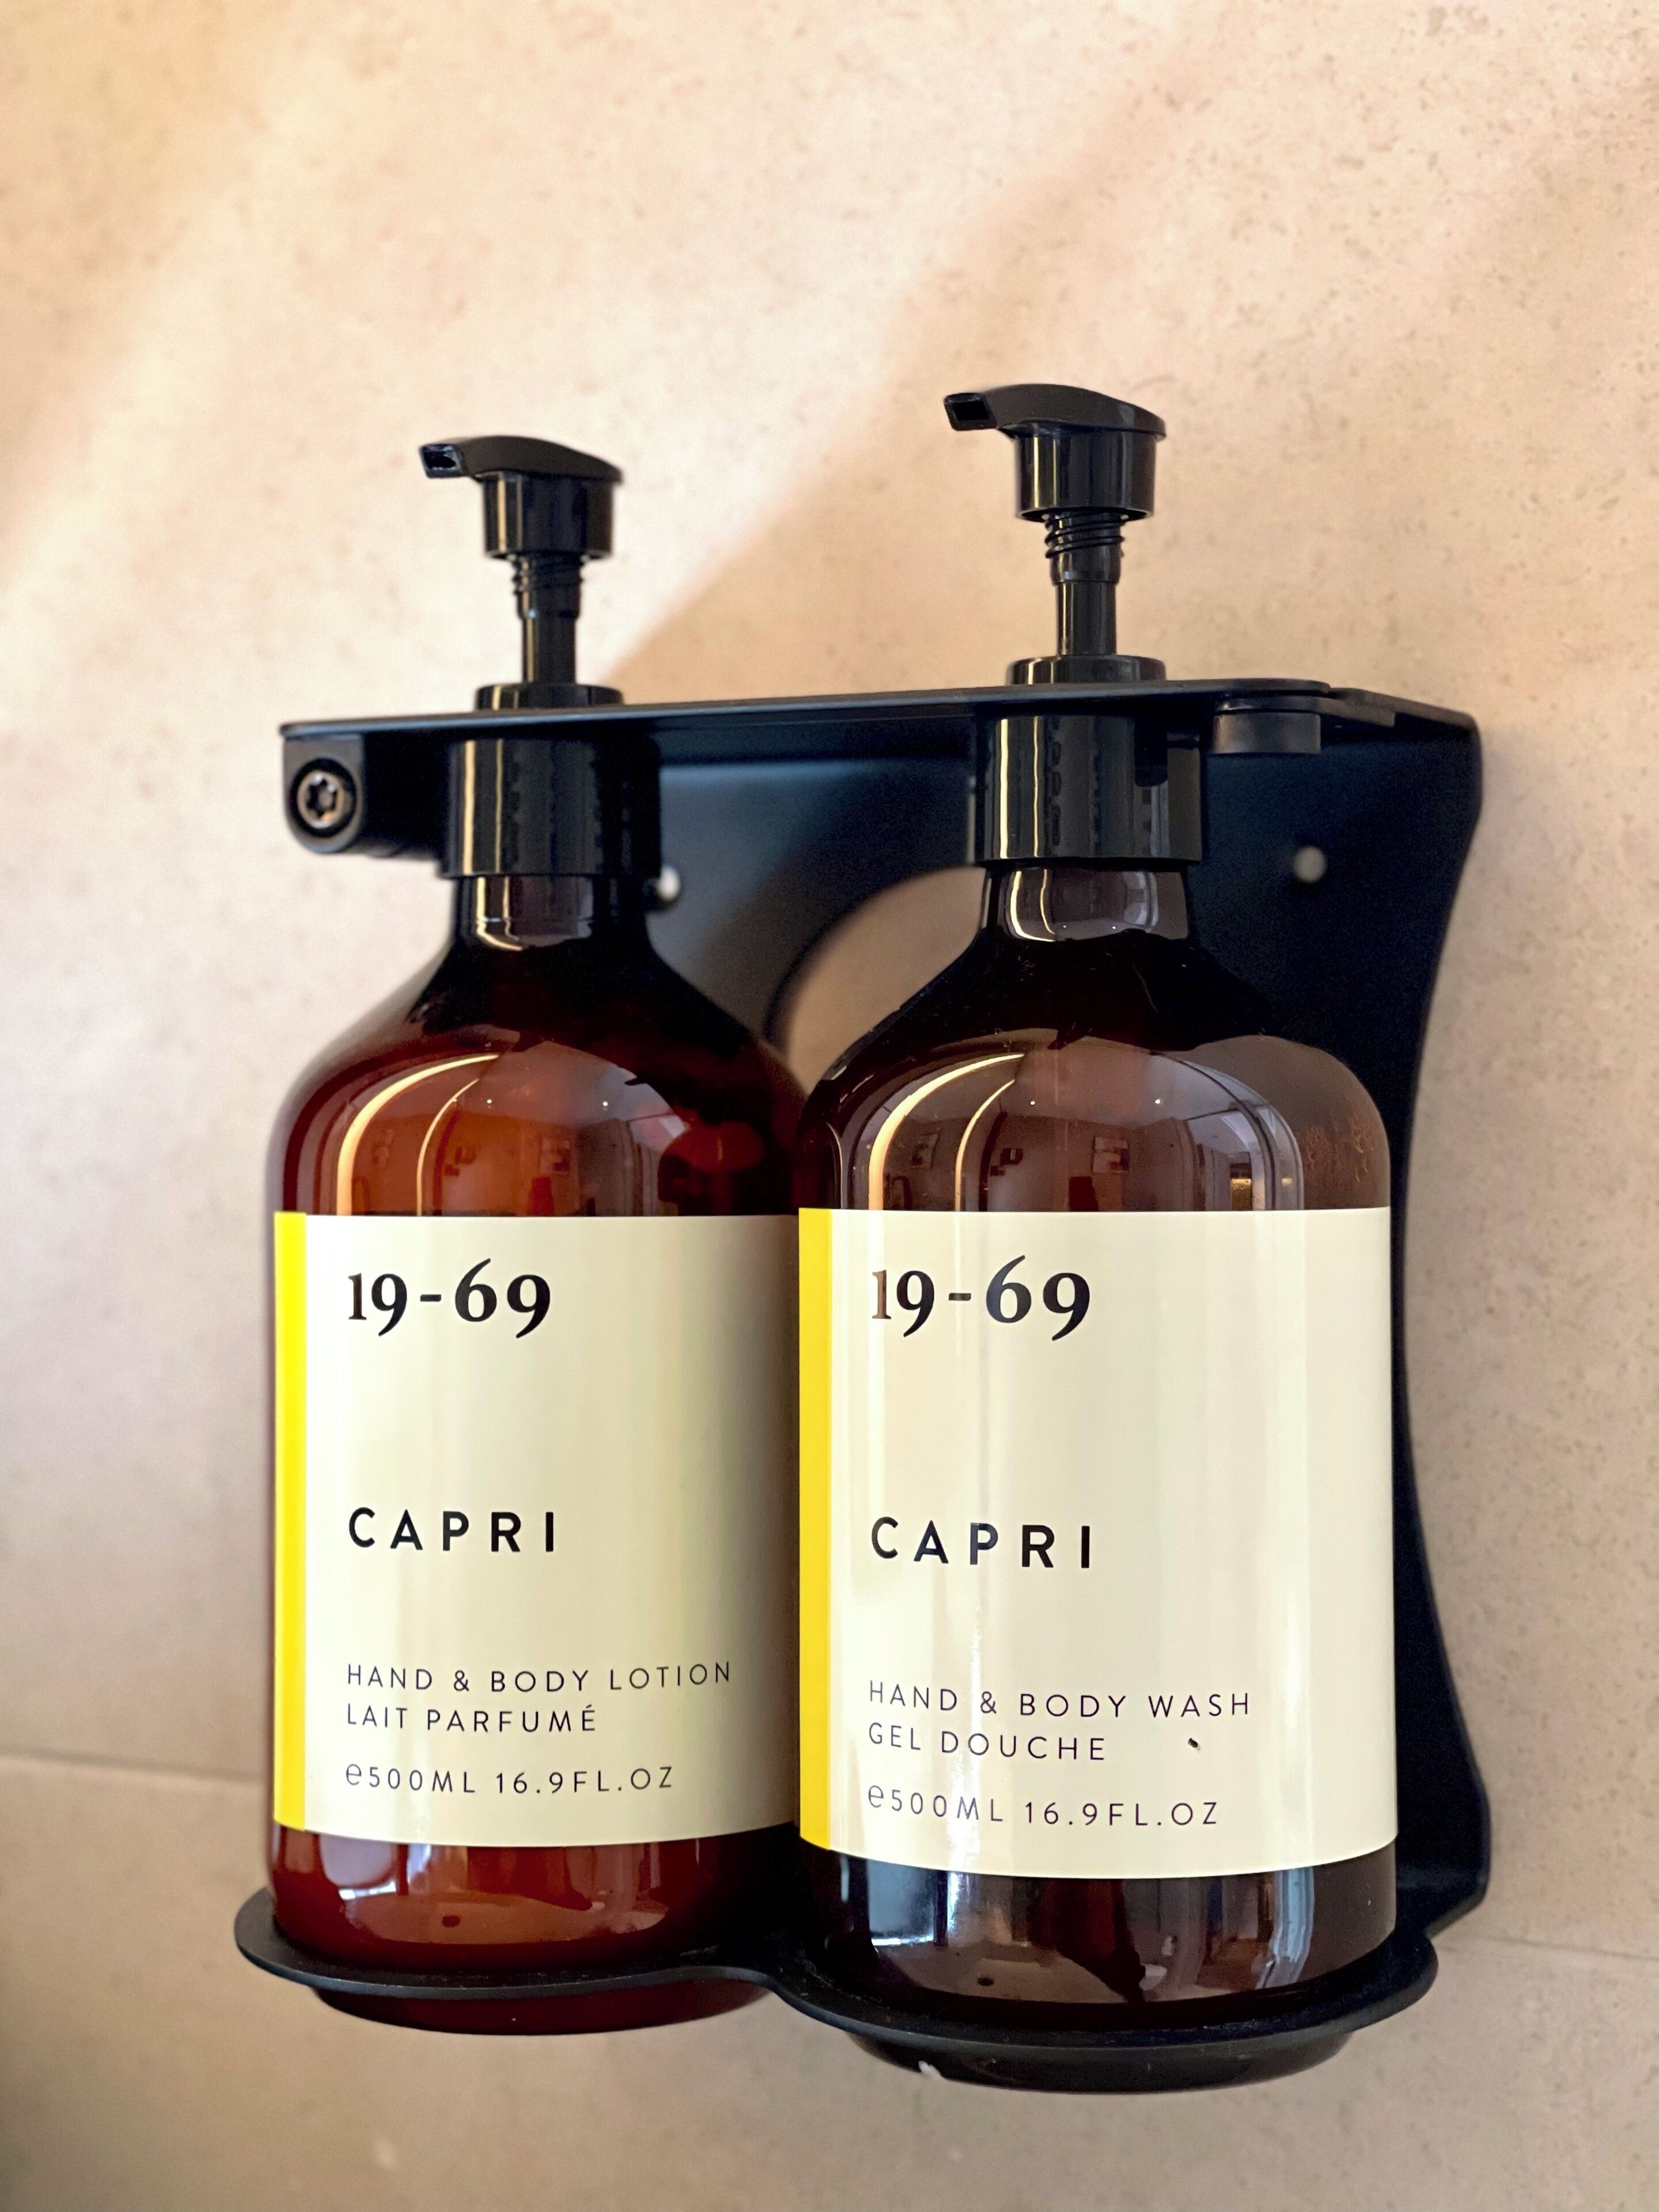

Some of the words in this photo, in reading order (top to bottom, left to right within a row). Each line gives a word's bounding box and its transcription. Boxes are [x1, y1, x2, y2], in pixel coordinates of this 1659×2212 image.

[347, 1257, 551, 1339] 19-69
[872, 1255, 1090, 1342] 19-69
[349, 1506, 554, 1553] CAPRI
[871, 1516, 1090, 1569] CAPRI
[347, 1663, 433, 1690] HAND
[453, 1669, 470, 1692] &
[491, 1669, 589, 1693] BODY
[609, 1661, 729, 1691] LOTION
[347, 1703, 408, 1729] LAIT
[427, 1703, 596, 1733] PARFUMÉ
[870, 1680, 957, 1711] HAND
[980, 1691, 997, 1714] &
[1020, 1693, 1127, 1718] BODY
[1147, 1692, 1248, 1718] WASH
[869, 1722, 921, 1751] GEL
[941, 1730, 1105, 1761] DOUCHE
[496, 1766, 672, 1794] 16.9FL.OZ
[1025, 1801, 1217, 1826] 16.9FL.OZ
